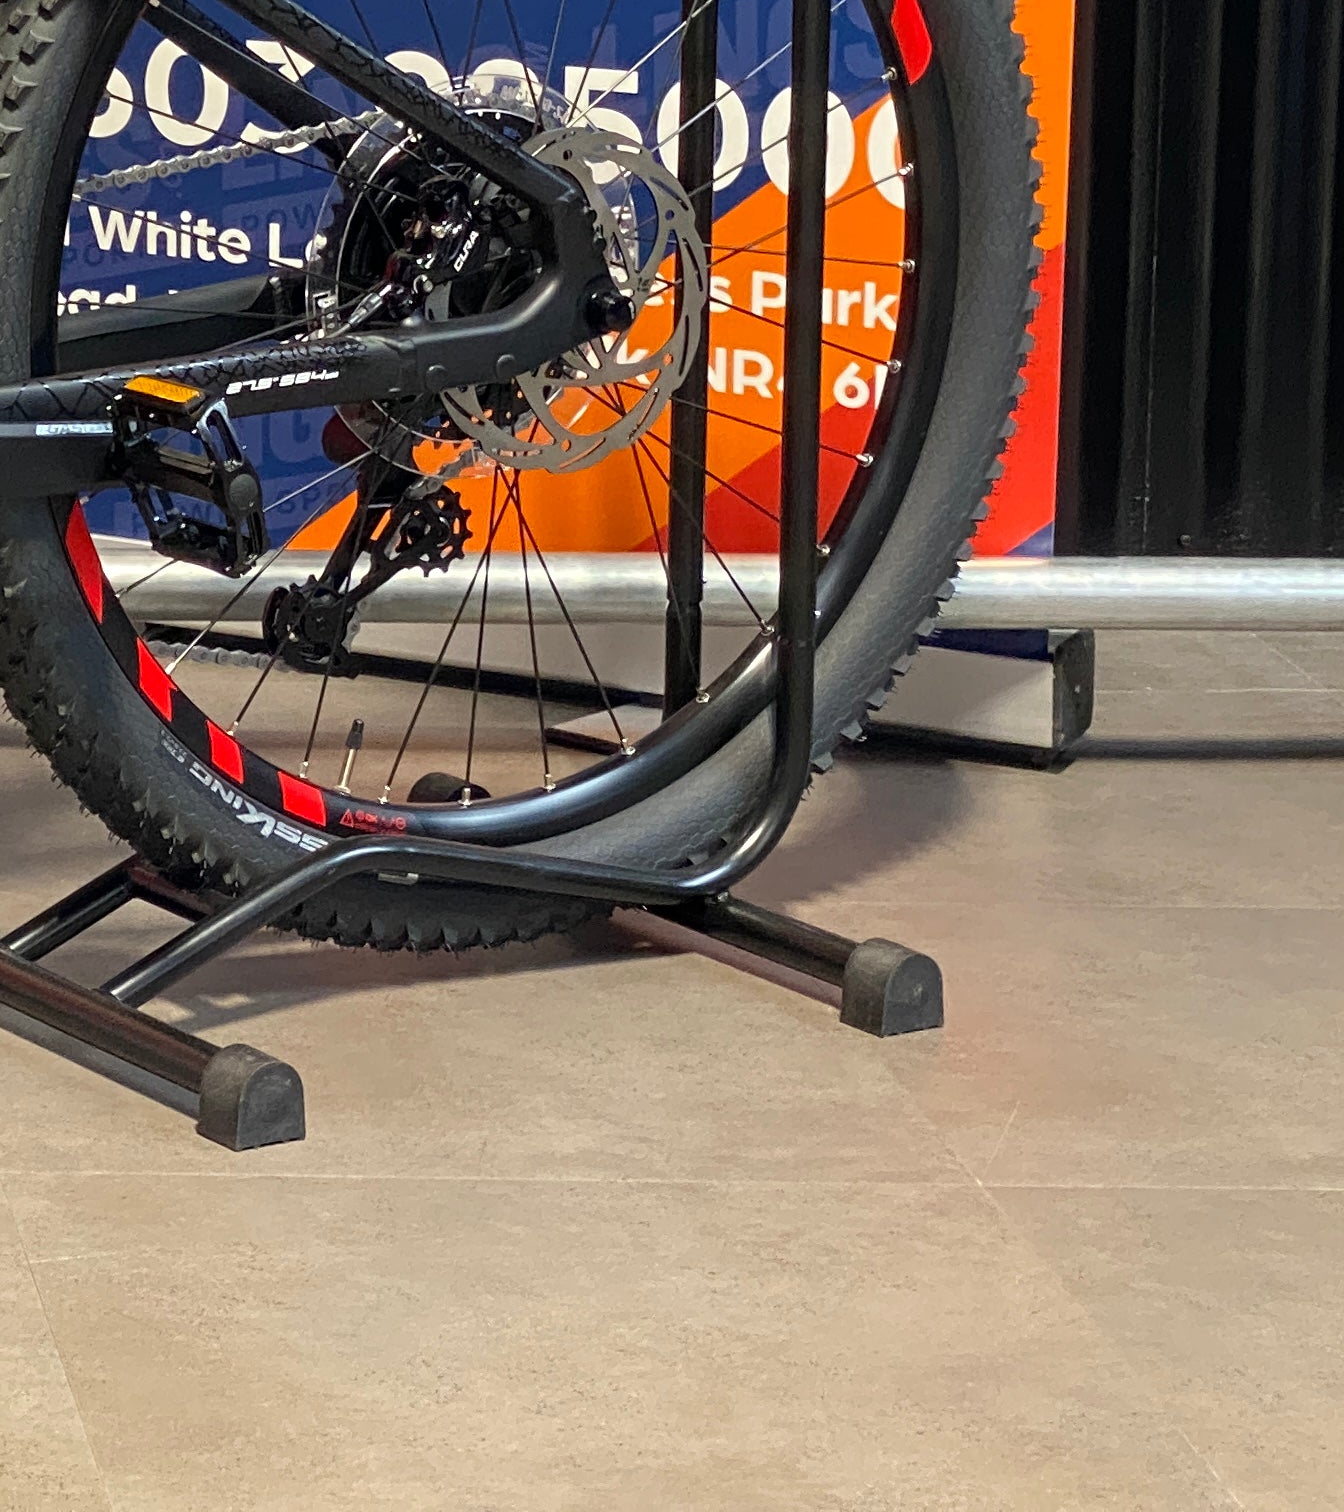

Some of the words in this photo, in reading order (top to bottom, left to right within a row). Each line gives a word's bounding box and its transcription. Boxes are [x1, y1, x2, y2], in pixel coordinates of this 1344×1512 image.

[87, 204, 251, 265] White
[452, 228, 481, 273] CURA
[751, 270, 900, 330] Prk
